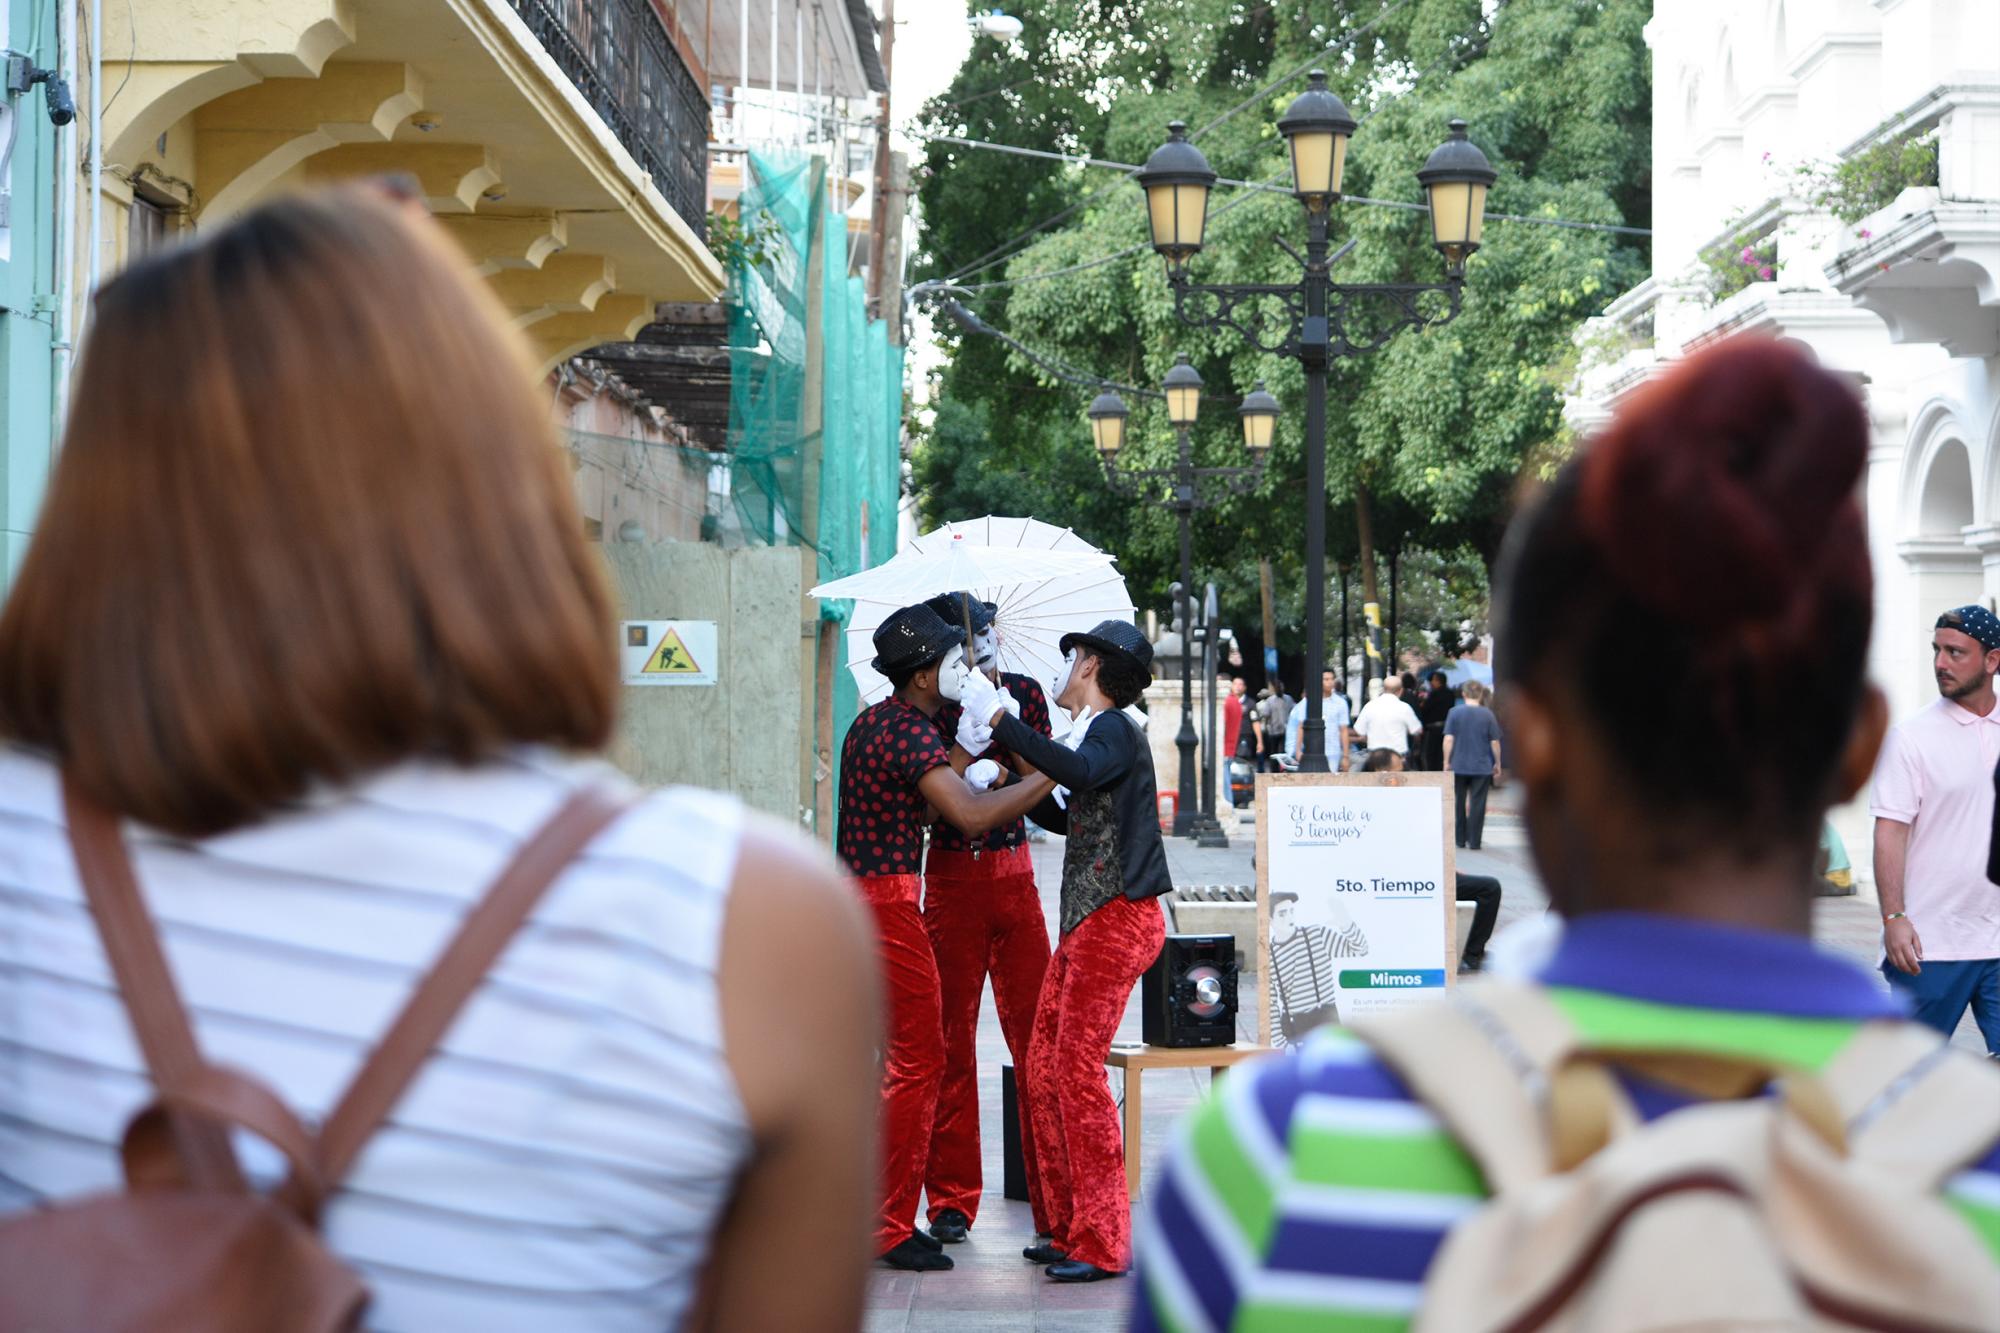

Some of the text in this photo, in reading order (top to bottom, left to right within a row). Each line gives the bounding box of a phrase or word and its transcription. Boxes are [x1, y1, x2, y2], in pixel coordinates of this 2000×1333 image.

[1312, 804, 1355, 822] Conde
[1360, 811, 1373, 821] a
[1295, 821, 1304, 838] 5
[1336, 878, 1435, 894] 5to. Tiempo
[1370, 972, 1422, 986] Mimos
